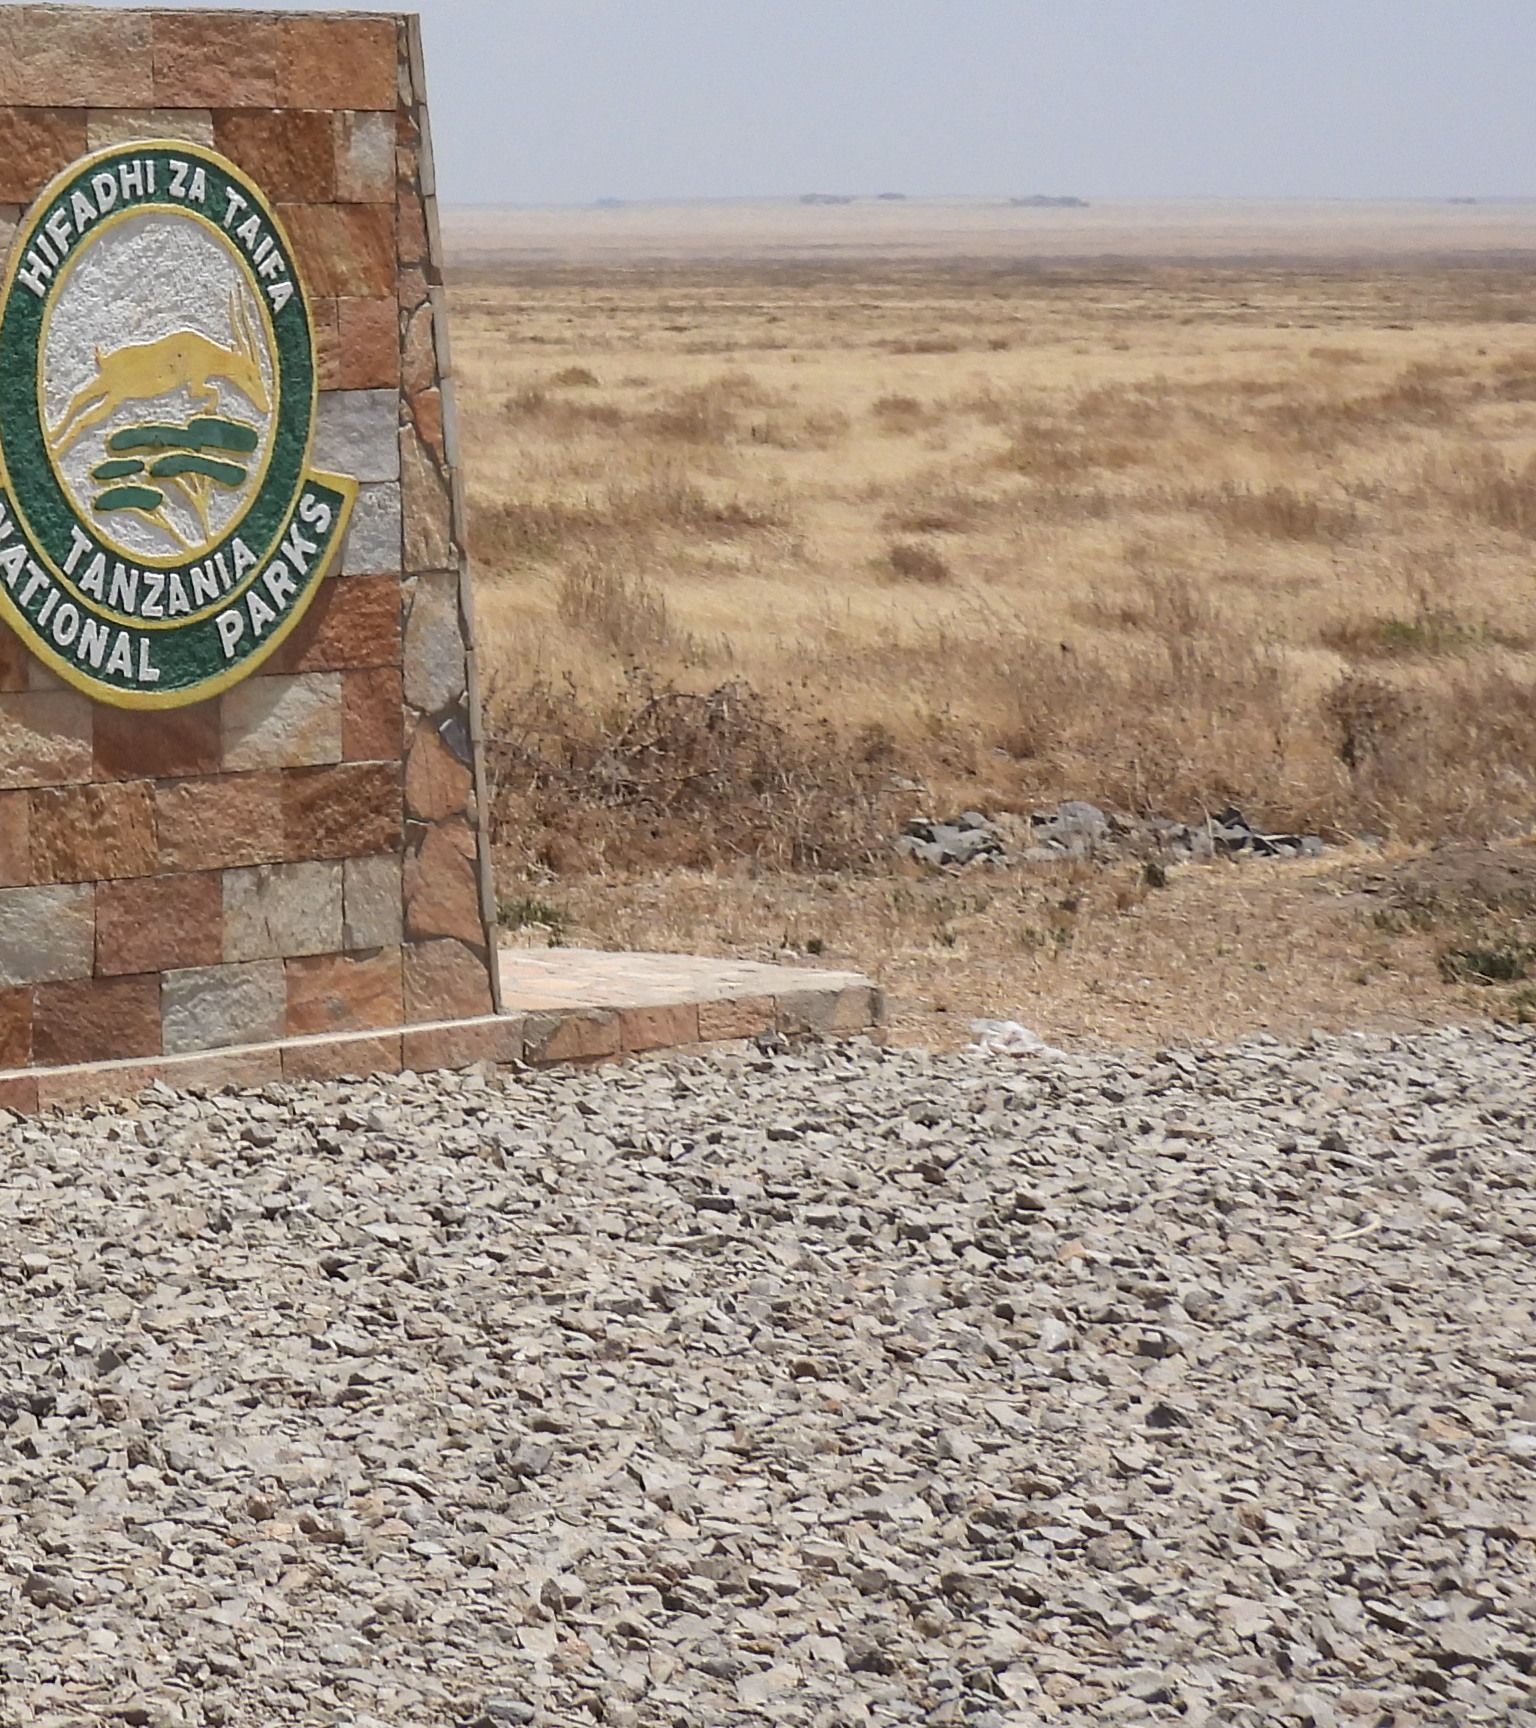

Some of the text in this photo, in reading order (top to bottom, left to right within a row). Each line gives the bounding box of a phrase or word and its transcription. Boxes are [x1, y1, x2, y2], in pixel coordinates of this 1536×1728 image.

[18, 160, 295, 314] HIFADHI ZA TAIFA
[62, 525, 263, 618] TANZANIA
[215, 493, 332, 659] PARKS
